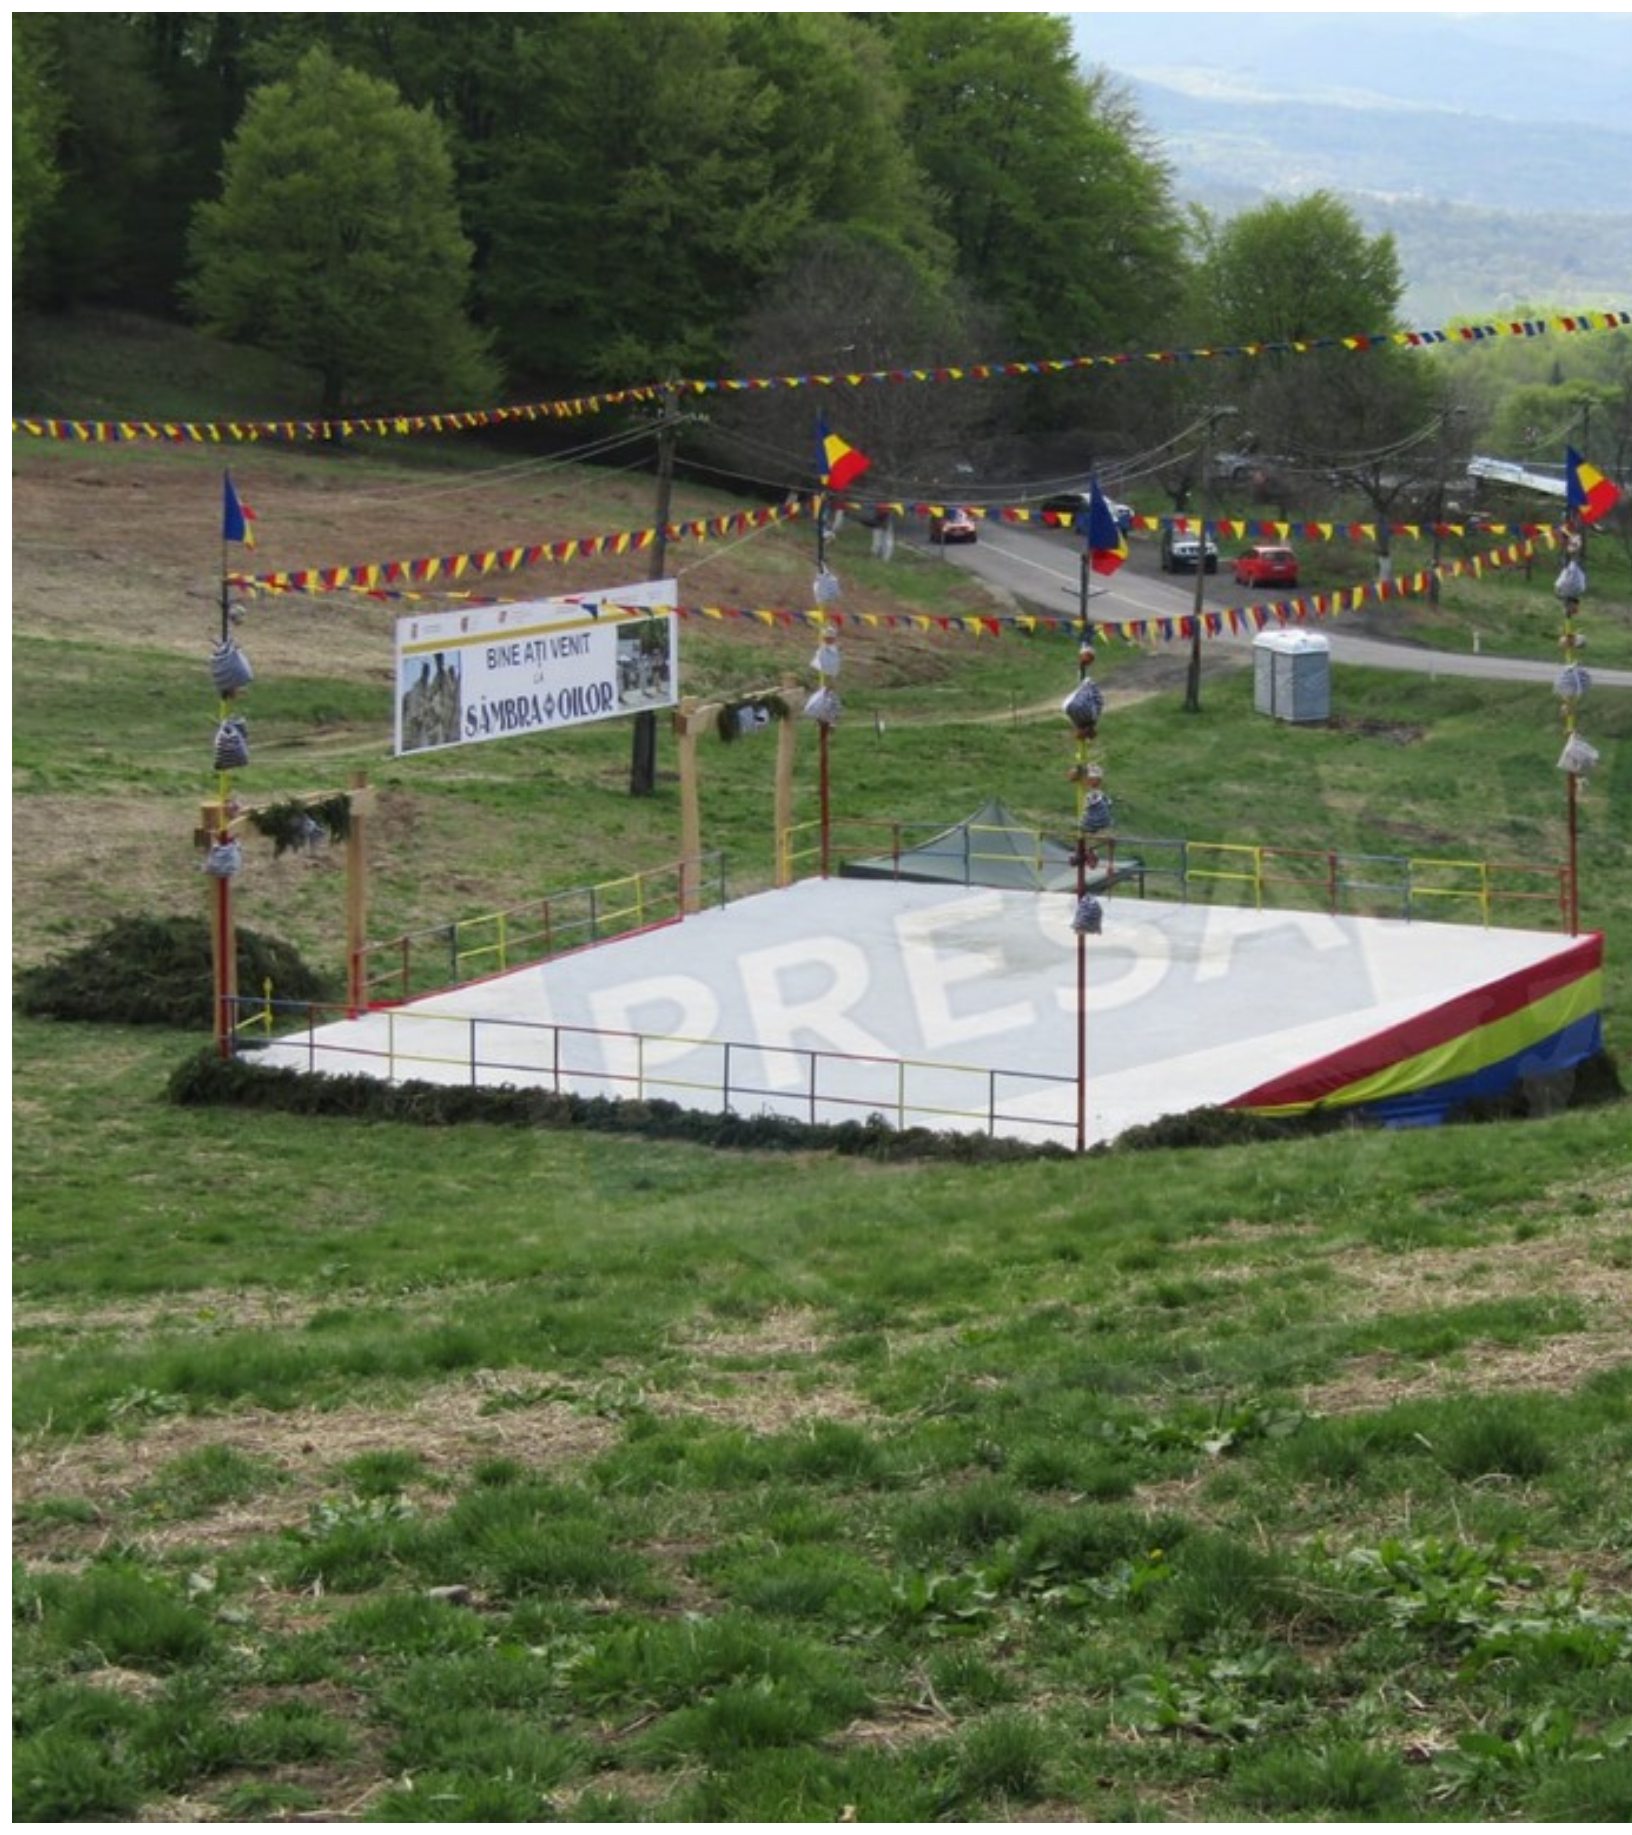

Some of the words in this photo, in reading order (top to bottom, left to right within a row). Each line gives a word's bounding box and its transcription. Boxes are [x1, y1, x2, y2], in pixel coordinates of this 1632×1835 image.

[486, 643, 521, 671] BINE
[550, 632, 591, 659] VENIT
[558, 681, 614, 720] OILOR
